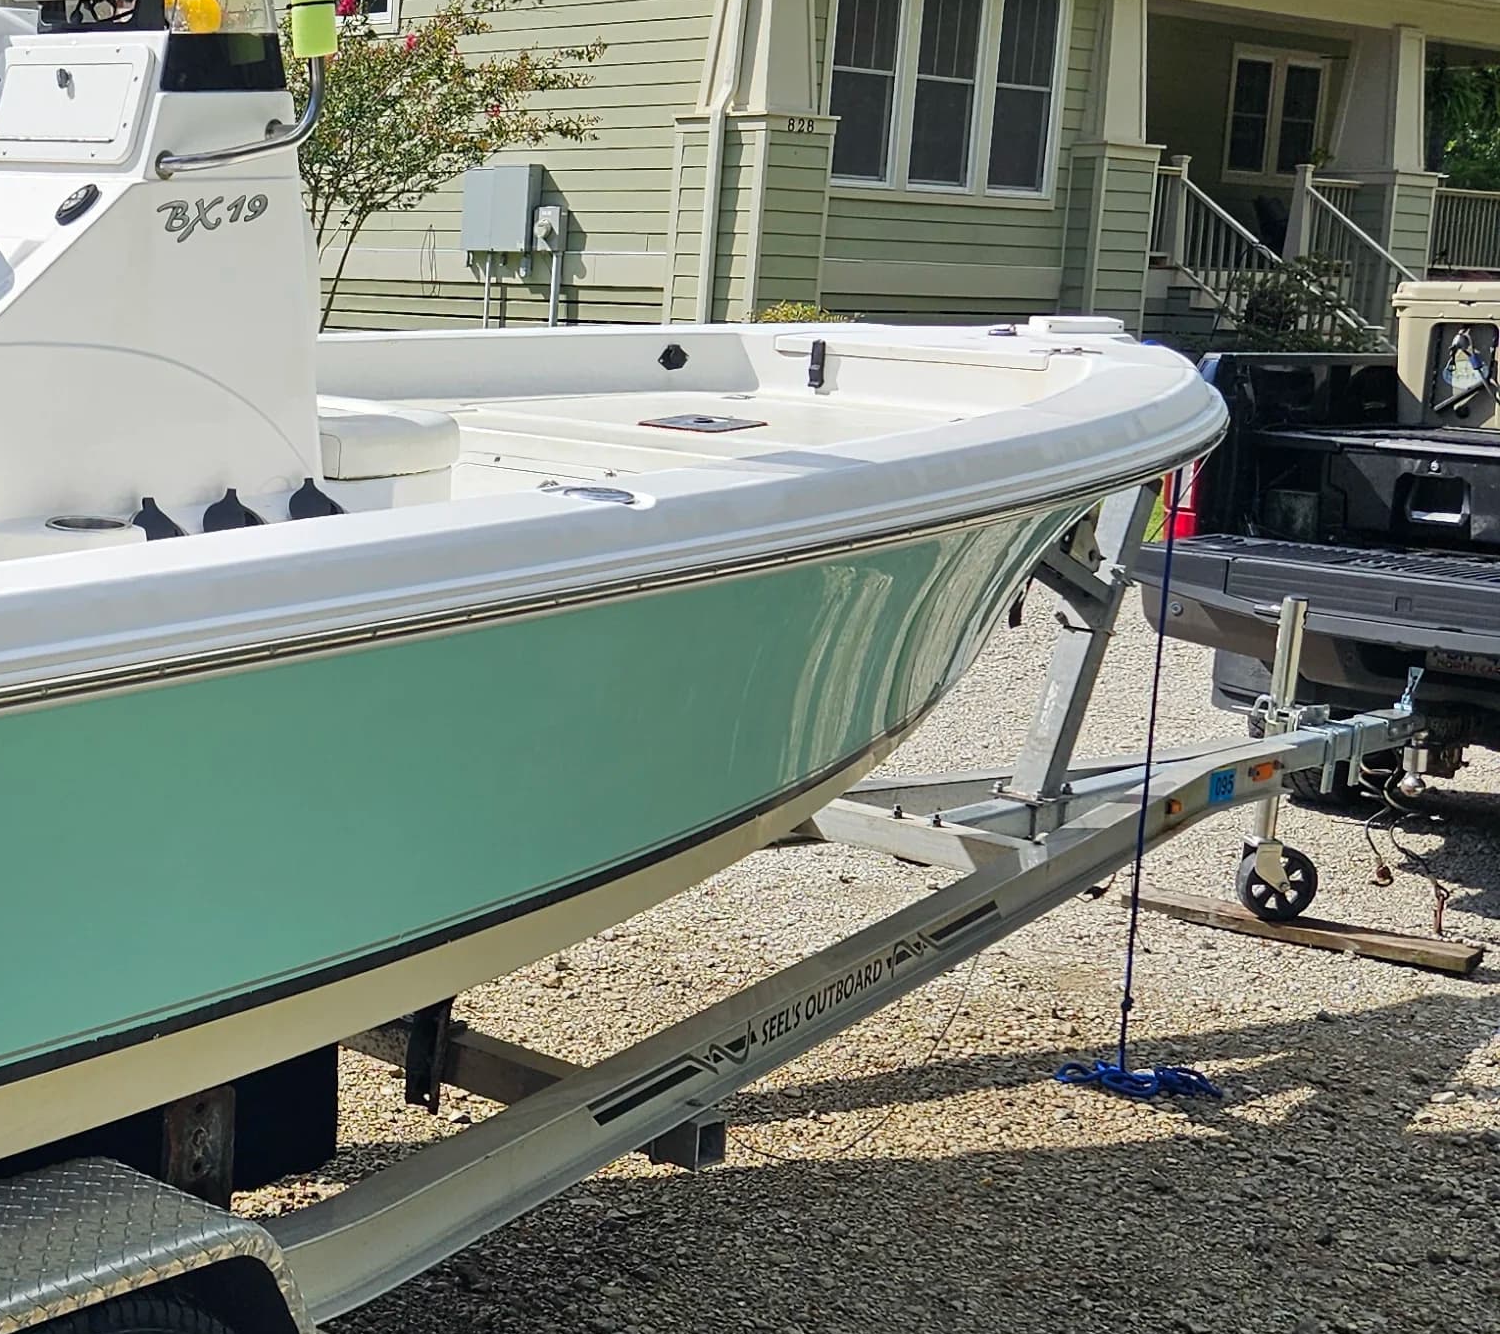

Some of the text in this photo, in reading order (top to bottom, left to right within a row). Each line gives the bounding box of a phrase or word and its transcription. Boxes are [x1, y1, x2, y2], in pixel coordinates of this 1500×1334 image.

[787, 118, 814, 133] 828
[156, 194, 269, 243] BX 19
[1214, 773, 1235, 796] 095
[762, 959, 883, 1046] SEEL'S OUTBOARD
